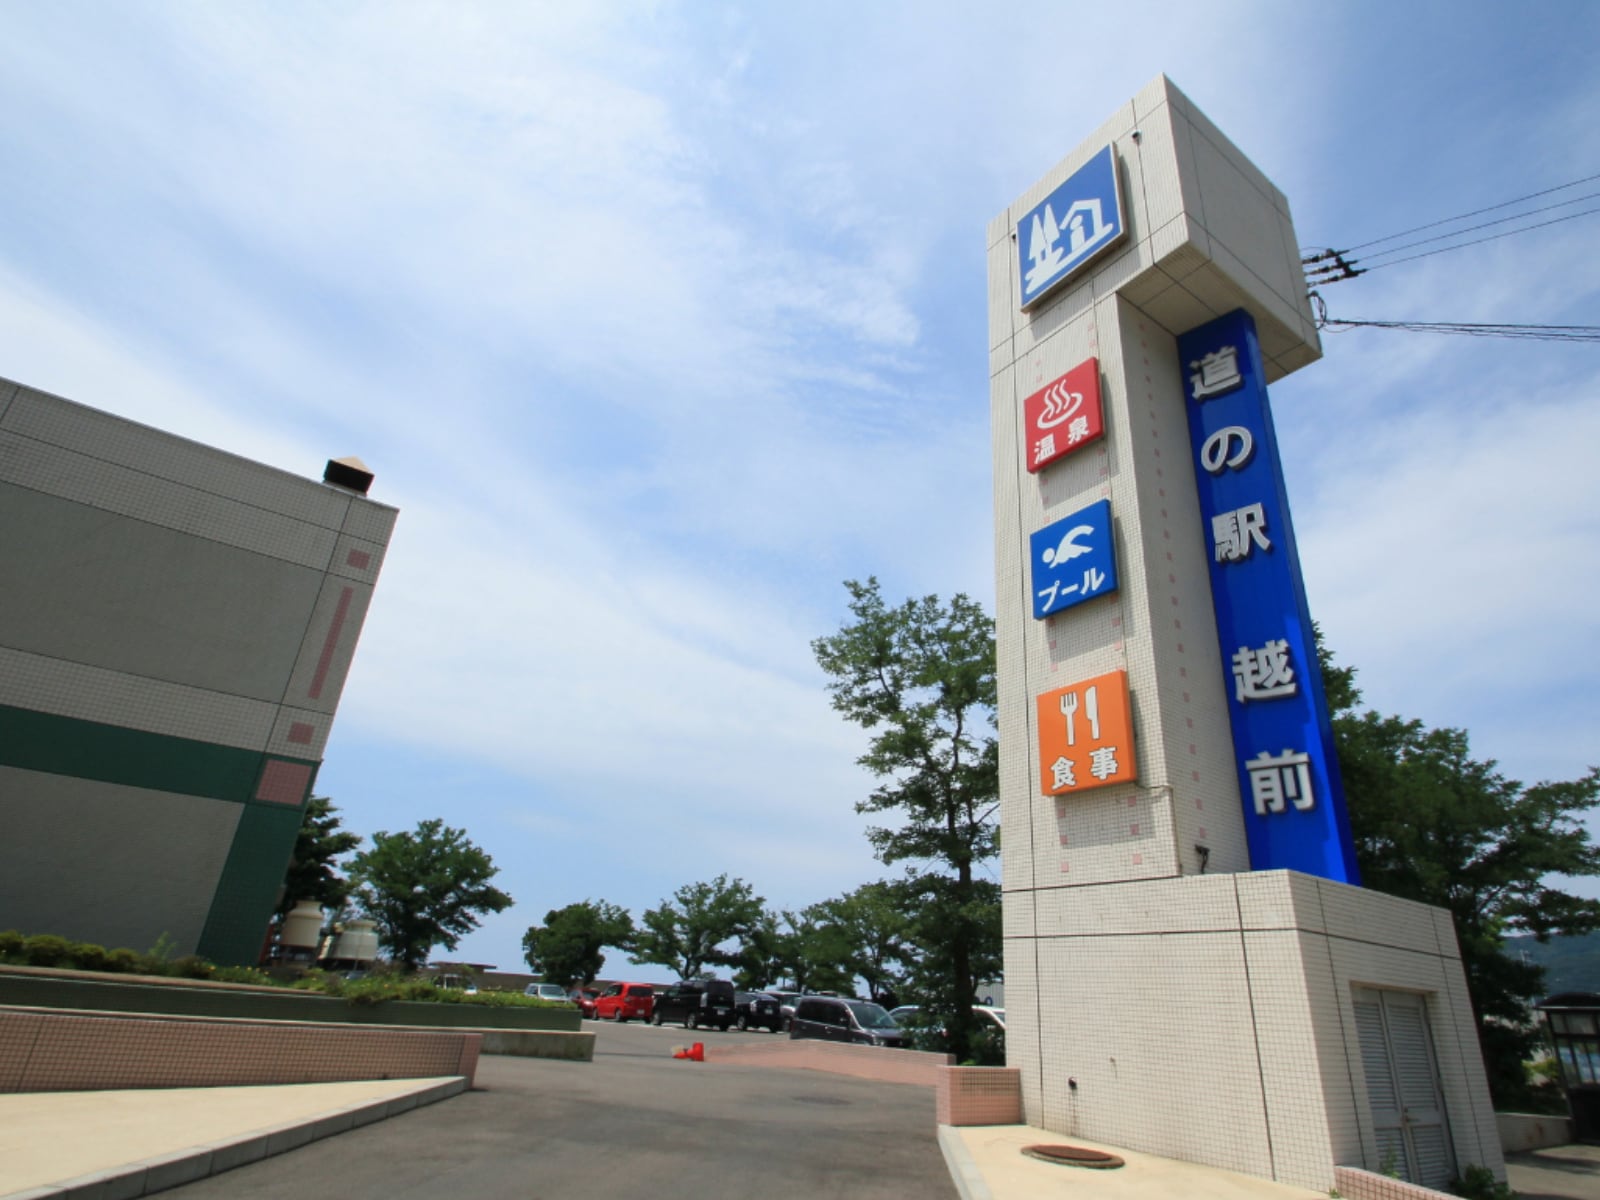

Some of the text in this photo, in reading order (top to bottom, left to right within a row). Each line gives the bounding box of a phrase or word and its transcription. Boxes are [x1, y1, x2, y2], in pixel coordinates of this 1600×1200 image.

[1034, 415, 1090, 464] 温泉
[1038, 567, 1105, 613] プール
[1050, 746, 1118, 791] 食事
